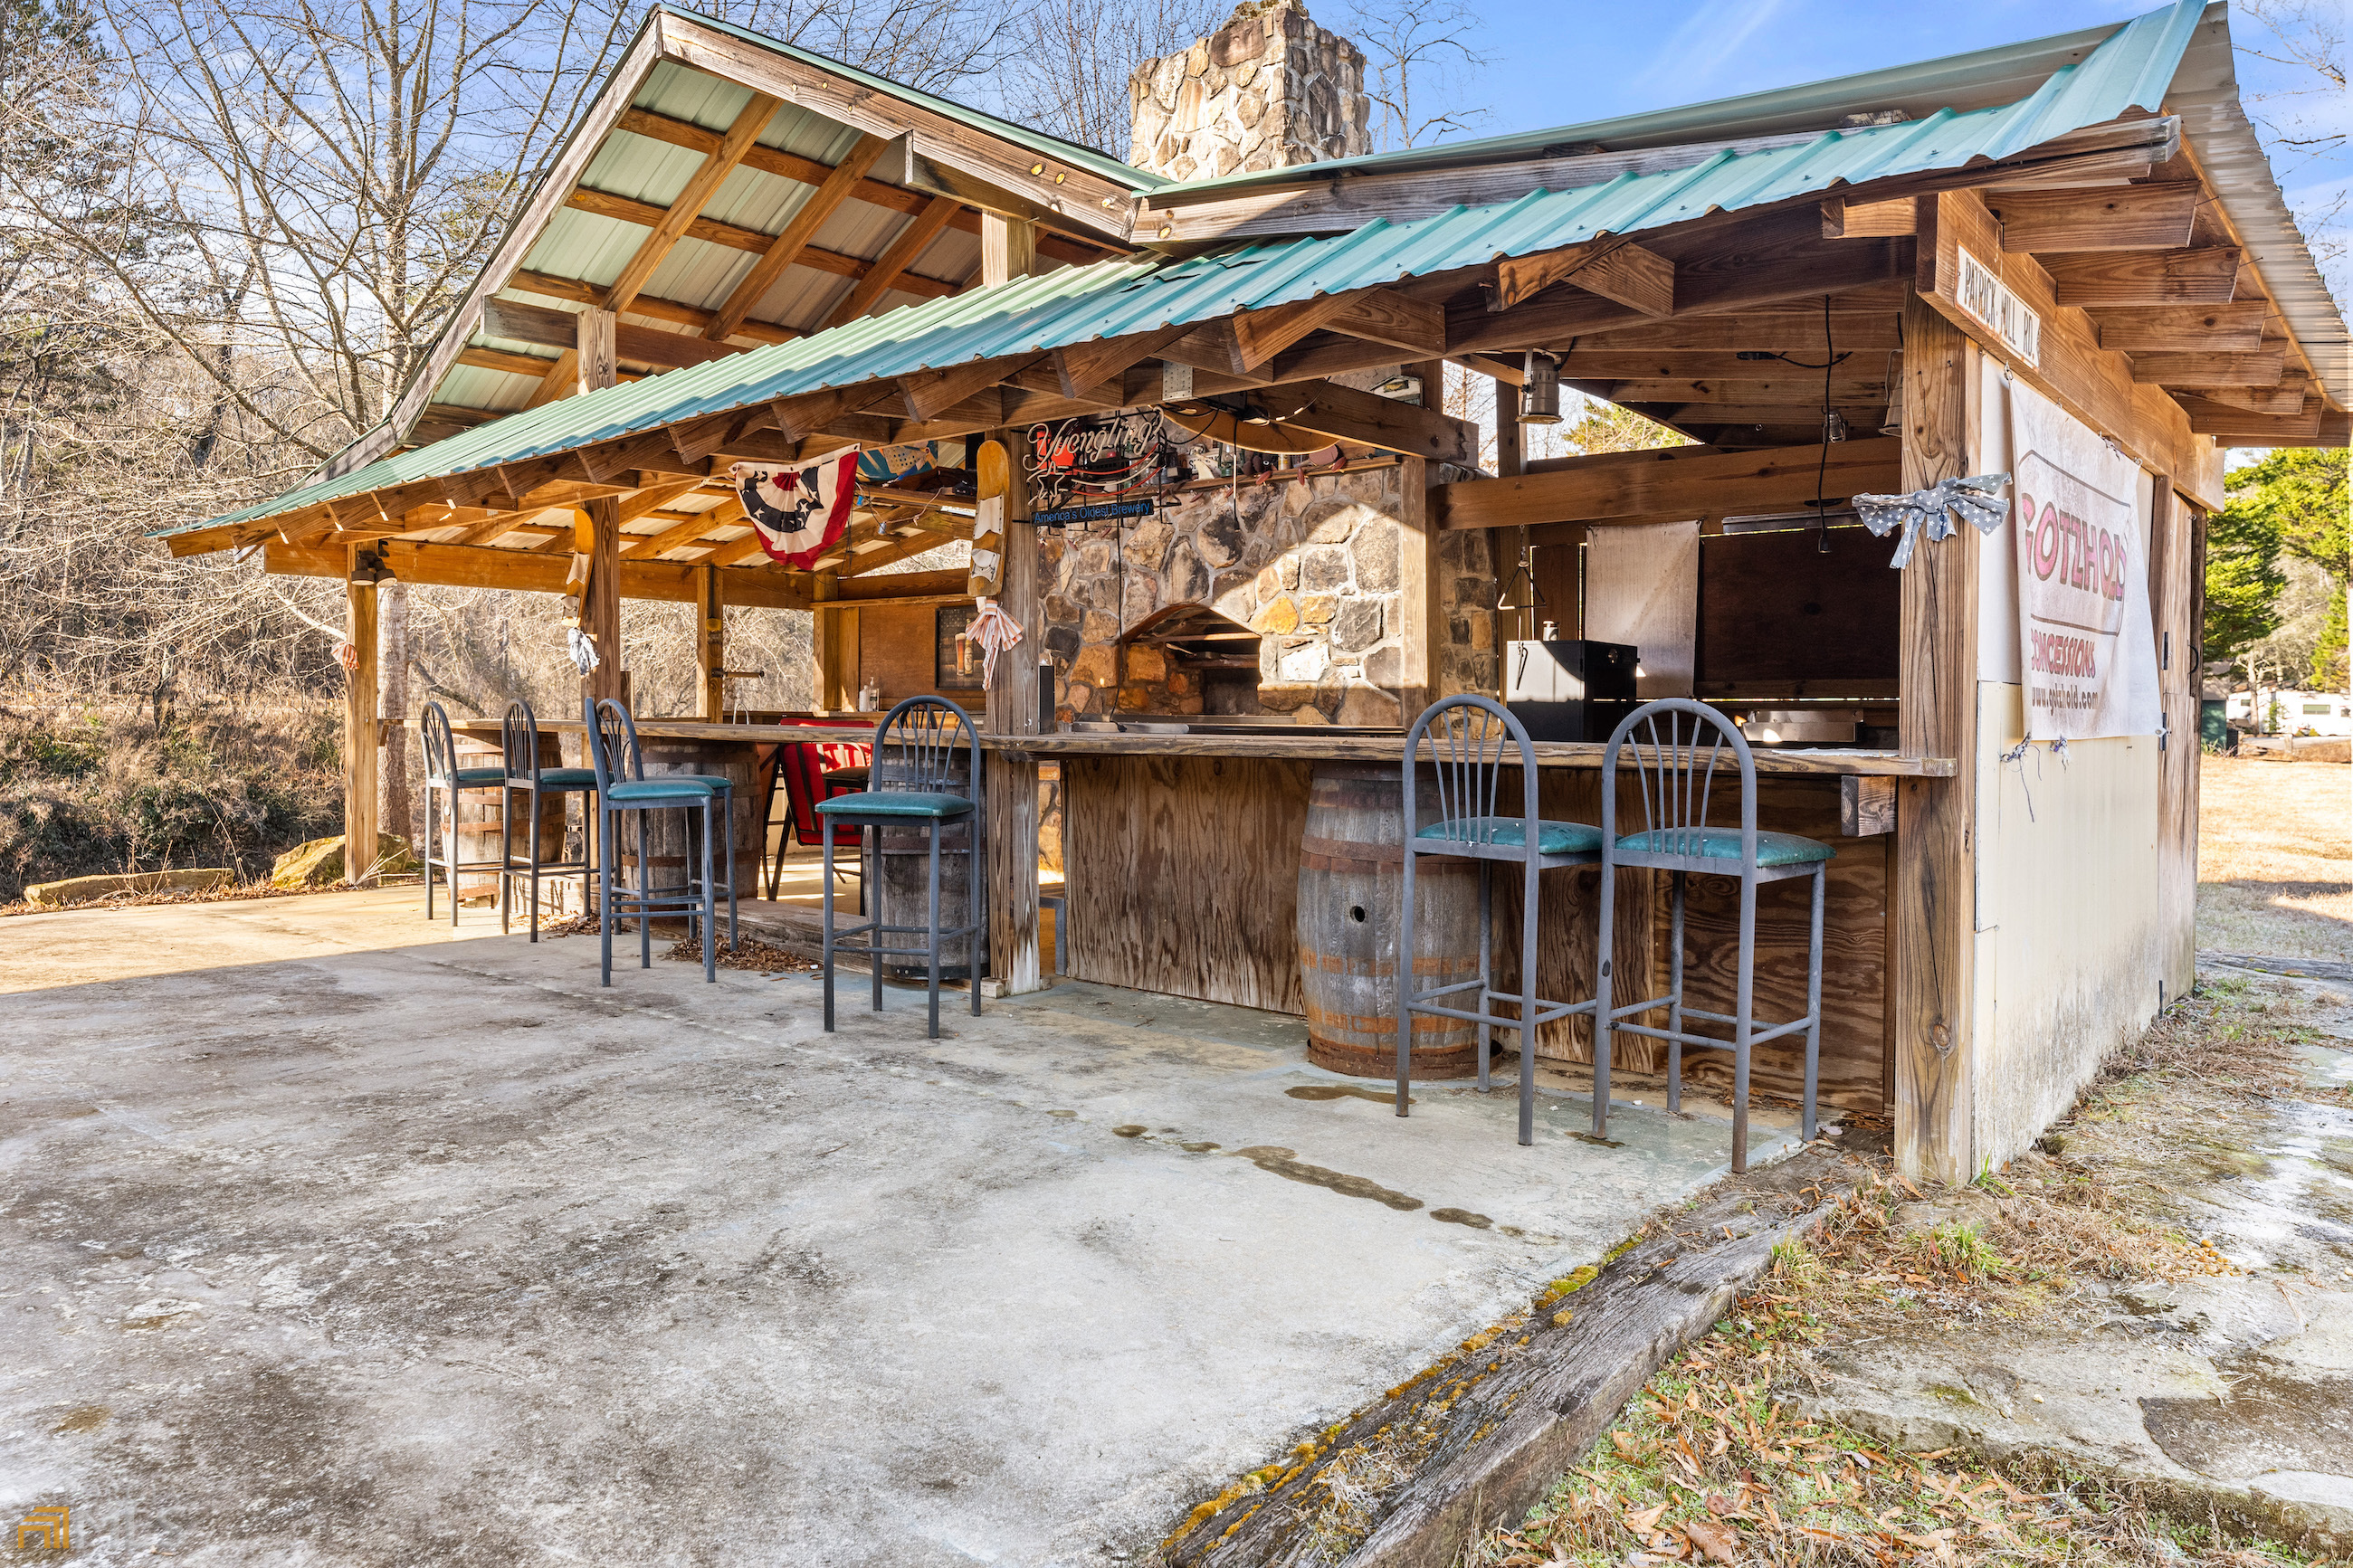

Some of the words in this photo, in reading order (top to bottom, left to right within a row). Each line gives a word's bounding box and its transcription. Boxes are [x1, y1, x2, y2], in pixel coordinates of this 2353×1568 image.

[1964, 257, 1997, 328] PATRICK
[1023, 407, 1164, 471] Yuengling
[1034, 509, 1077, 524] America's
[1080, 507, 1109, 518] Oldest
[1111, 502, 1150, 517] Brewery
